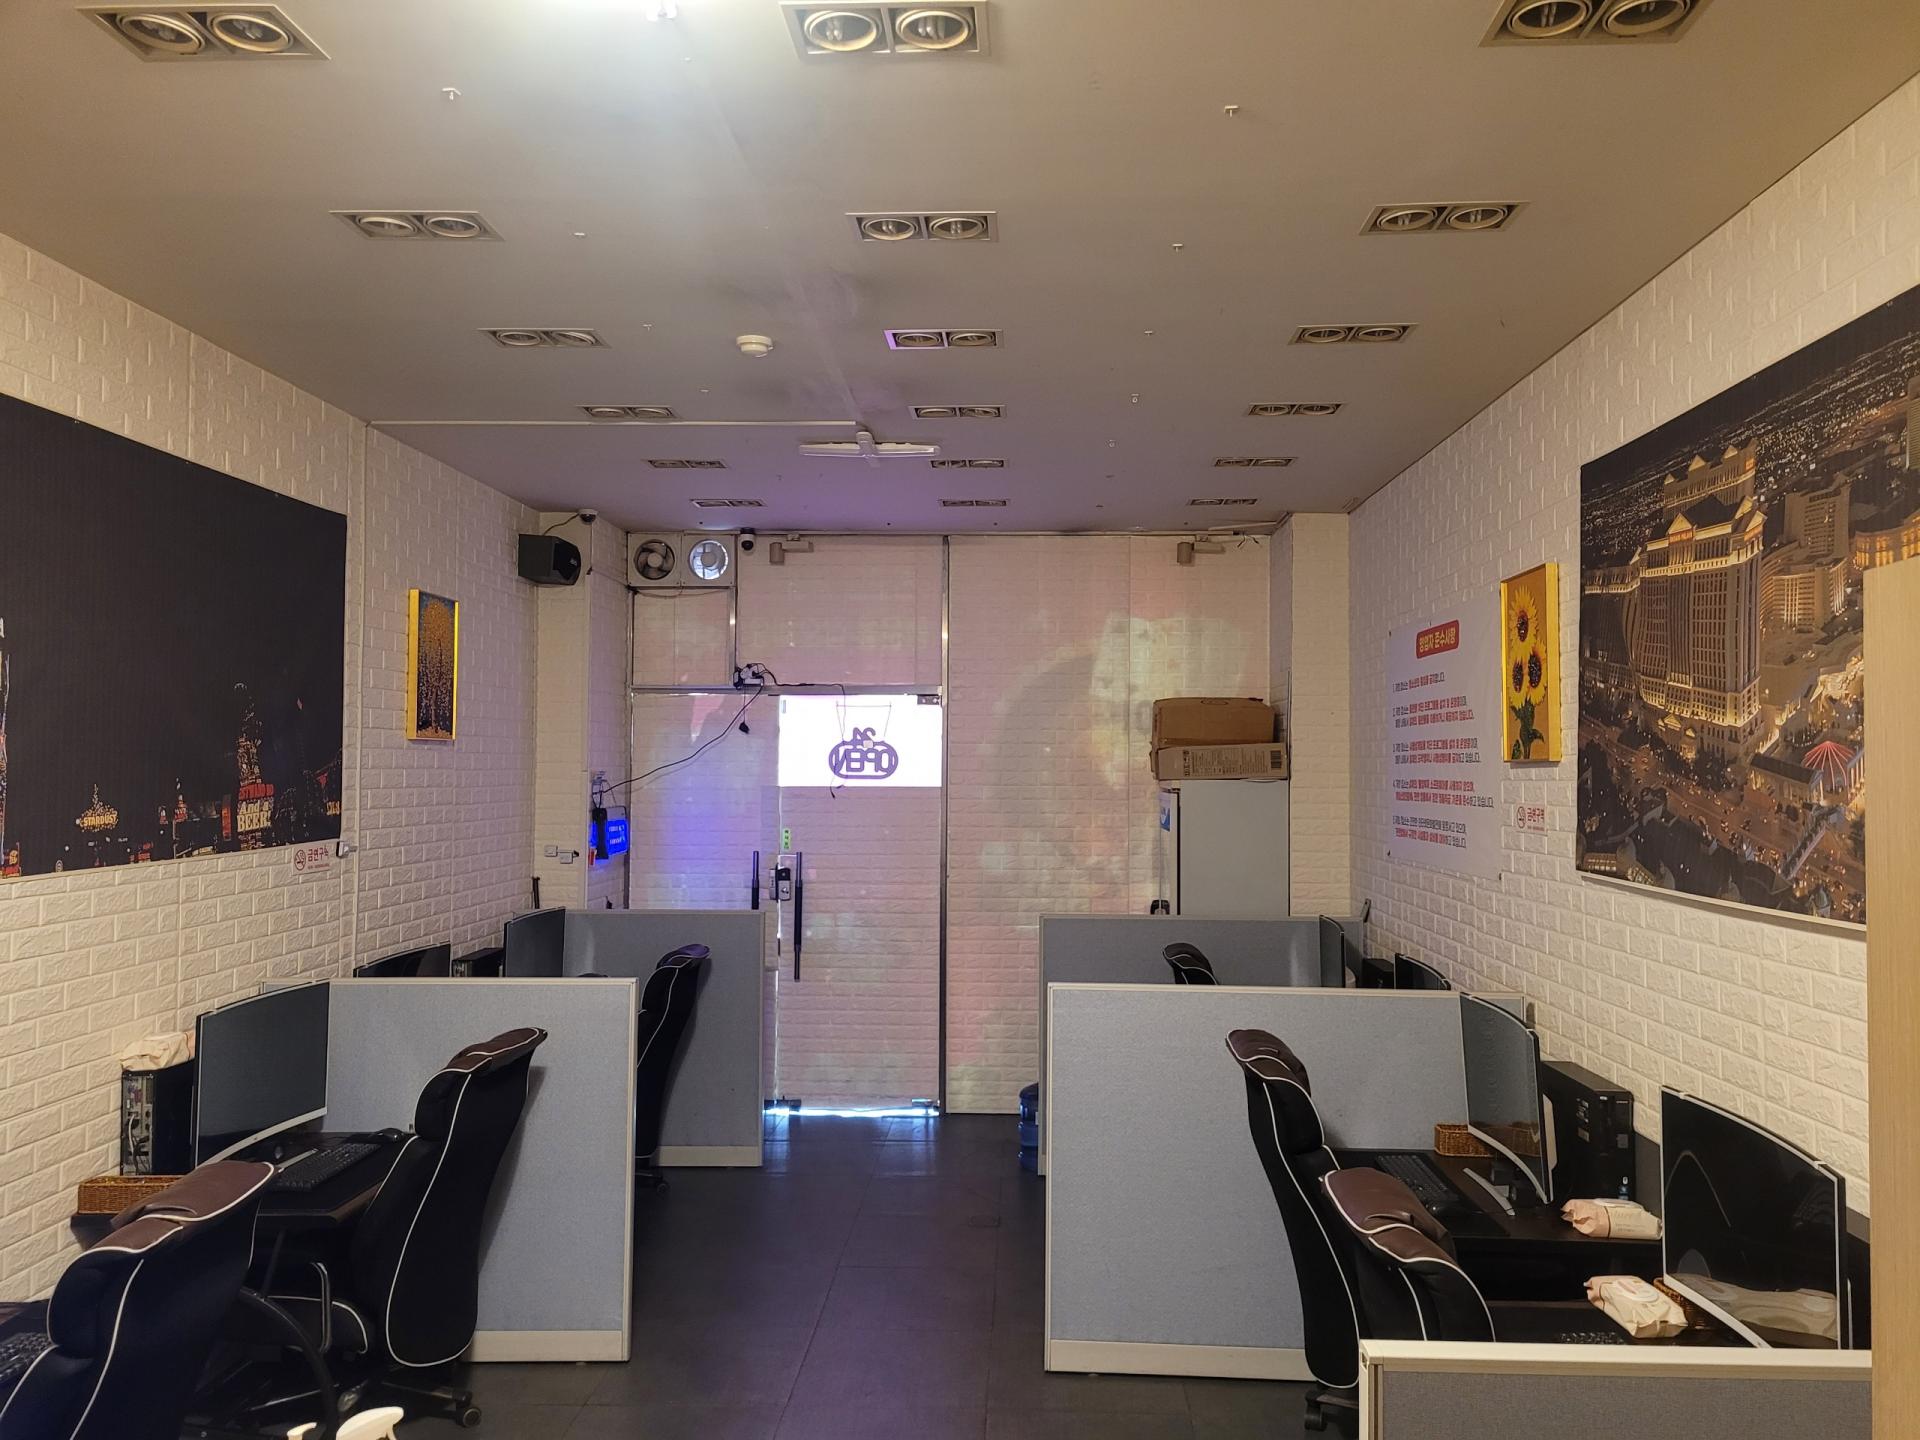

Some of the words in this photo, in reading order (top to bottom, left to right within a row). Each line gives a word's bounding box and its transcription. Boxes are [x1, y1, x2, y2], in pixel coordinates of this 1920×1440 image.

[239, 800, 260, 815] And
[83, 811, 118, 827] STARDUST
[237, 811, 272, 832] BEER!
